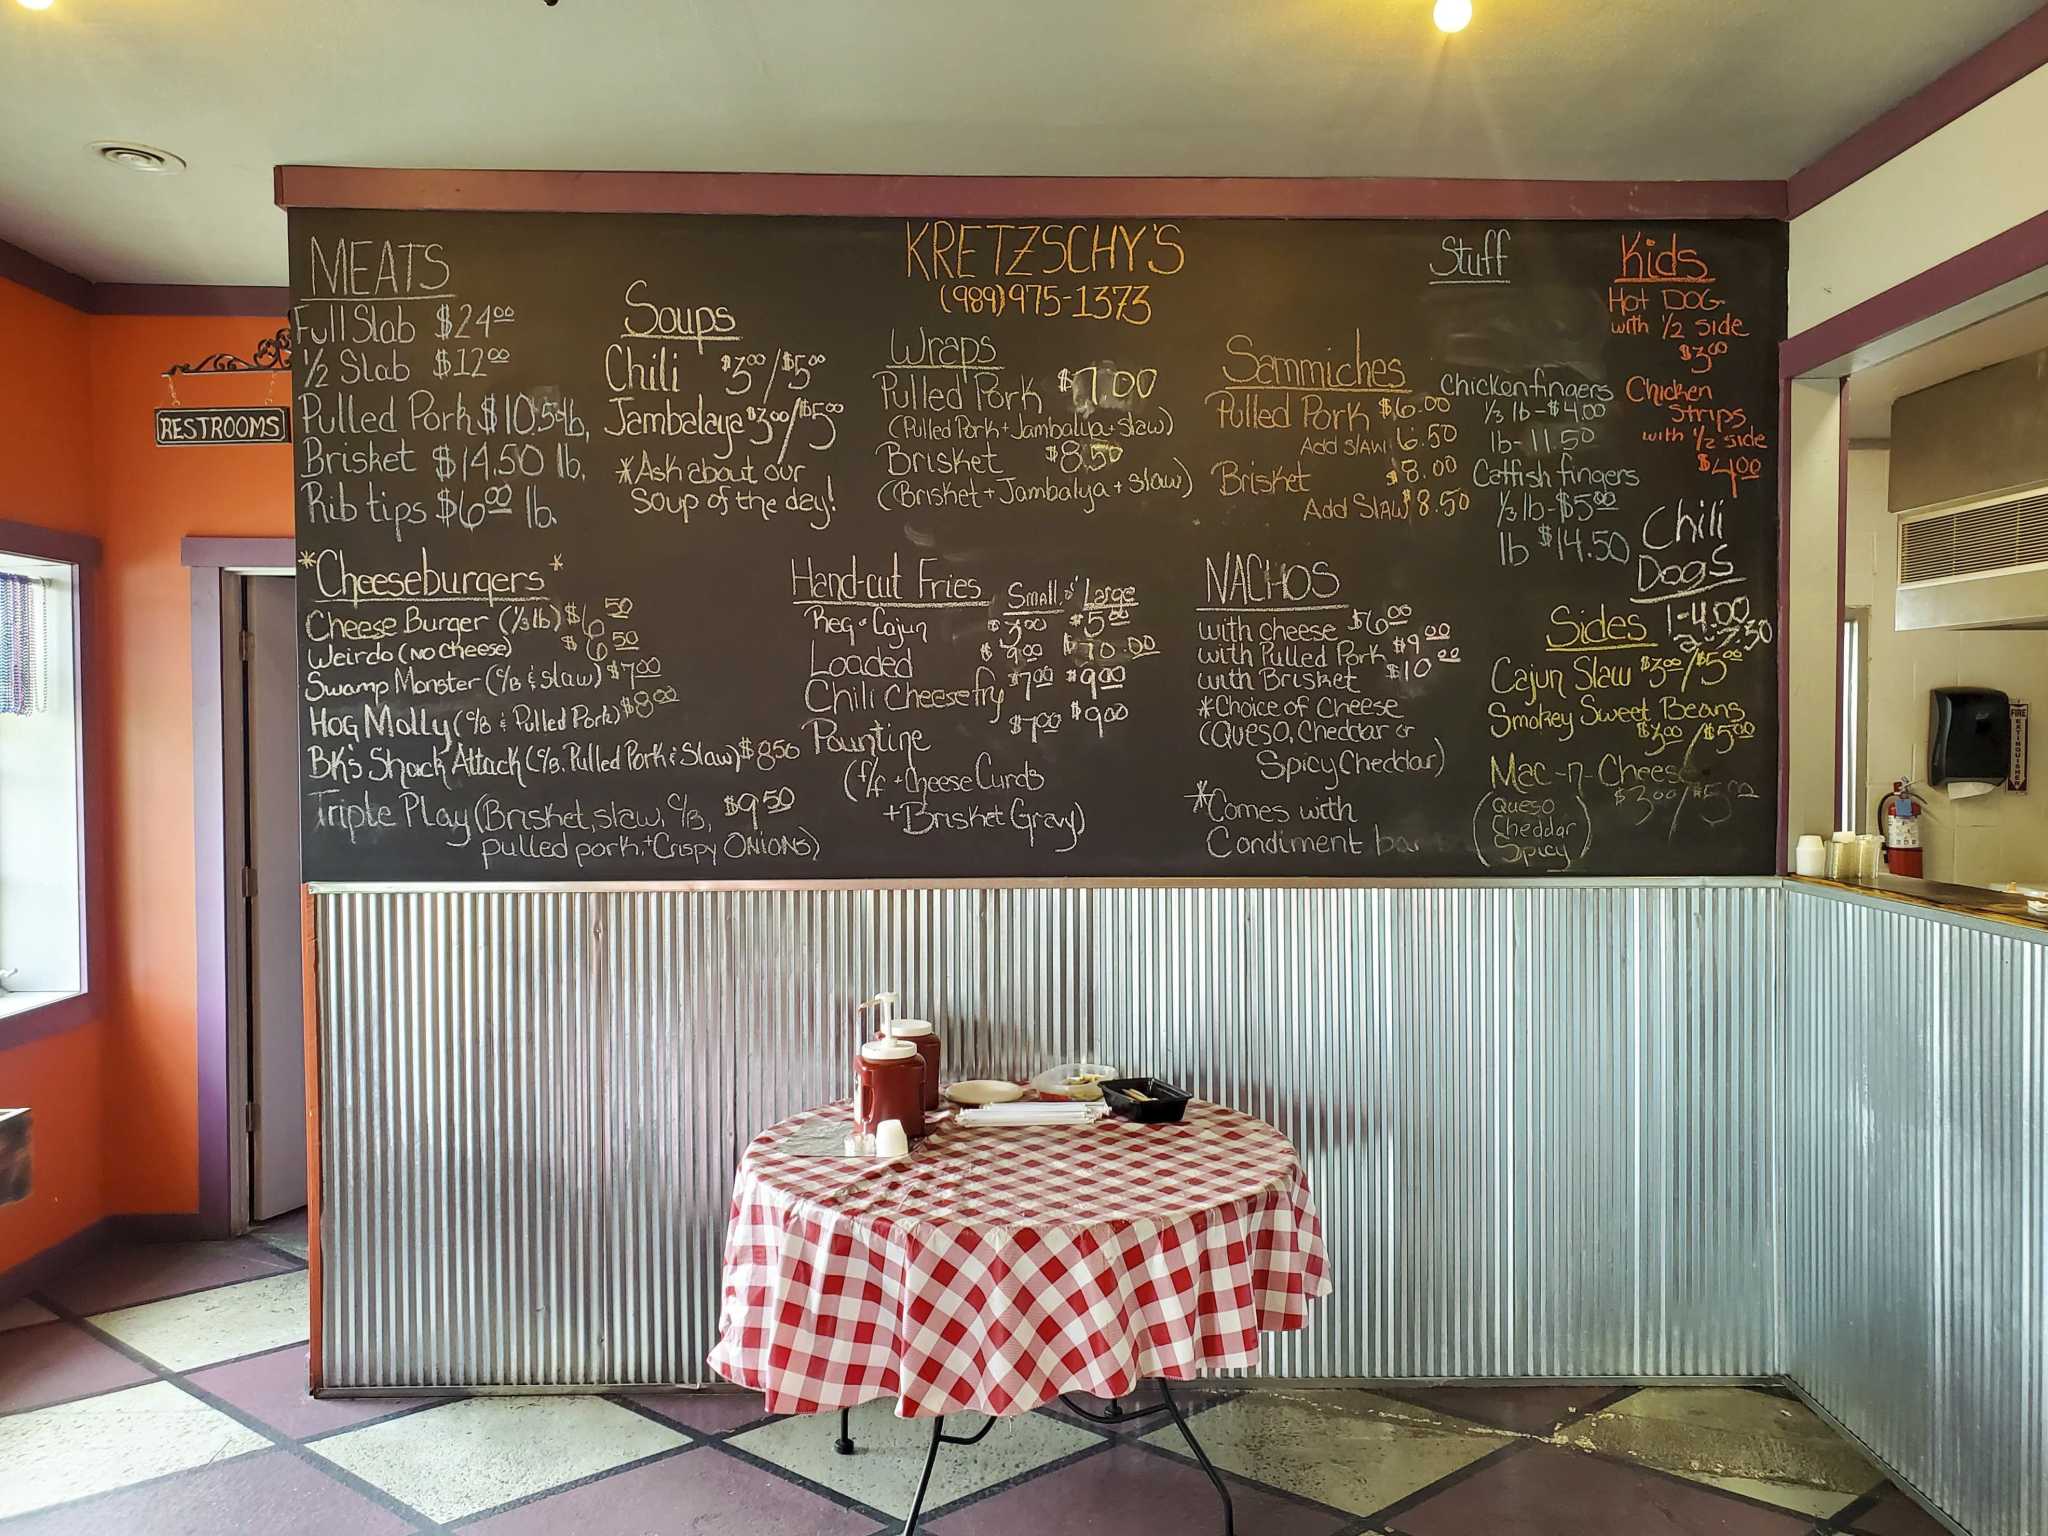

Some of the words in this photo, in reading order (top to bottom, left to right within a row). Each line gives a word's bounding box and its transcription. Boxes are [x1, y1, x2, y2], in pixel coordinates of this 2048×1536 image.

[310, 235, 450, 296] MEATS
[906, 221, 1185, 281] KRETZSCHY'S
[1429, 229, 1511, 276] Stuff
[1621, 232, 1708, 280] Kids
[624, 279, 736, 355] Soups
[1608, 286, 1650, 315] Hot
[294, 303, 345, 344] Full
[353, 303, 416, 344] Slab
[1611, 314, 1648, 335] with
[1695, 313, 1750, 337] side
[340, 348, 410, 385] Slab
[605, 343, 681, 392] Chili
[890, 327, 997, 384] Wraps
[1222, 327, 1406, 388] Sammiches
[872, 370, 963, 412] Pulled
[974, 370, 1042, 414] Pork
[1626, 376, 1712, 406] Chicken
[160, 416, 280, 440] RESTROOMS
[298, 392, 397, 434] Pulled
[409, 389, 476, 435] Pork
[954, 414, 1000, 439] Pork
[1204, 390, 1292, 429] Pulled
[1301, 394, 1370, 432] Pork
[1668, 403, 1747, 432] Strips
[1300, 436, 1338, 455] Add
[1642, 427, 1684, 442] with
[1724, 425, 1768, 449] side
[300, 437, 417, 477] Brisket
[688, 454, 758, 484] about
[764, 463, 806, 483] our
[875, 441, 1004, 476] Brisket
[1473, 458, 1552, 488] Catfish
[1556, 452, 1640, 492] fingers
[1210, 459, 1312, 496] Brisket
[300, 481, 358, 524] Rib
[366, 481, 427, 543] tips
[707, 485, 731, 516] of
[736, 488, 778, 520] the
[1303, 496, 1347, 521] Add
[1642, 497, 1724, 550] Chili
[1500, 531, 1530, 566] lb
[919, 558, 982, 600] Fries
[1084, 578, 1136, 607] Large
[1206, 551, 1339, 605] NACHOS
[305, 609, 397, 642] Cheese
[403, 606, 488, 645] Burger
[871, 607, 927, 650] Cajun
[1199, 618, 1254, 642] with
[1546, 604, 1647, 649] Sides
[308, 641, 394, 670] Weirdo
[811, 640, 913, 678] Loaded
[1198, 643, 1254, 668] with
[1259, 642, 1328, 668] Pulled
[1337, 639, 1388, 667] Pork
[305, 670, 389, 706] Swamp
[395, 666, 481, 694] Monster
[805, 679, 875, 716] Chili
[1197, 667, 1254, 690] with
[1259, 665, 1361, 693] Brisket
[1491, 656, 1567, 706] Cajun
[1573, 655, 1632, 691] Slaw
[1284, 696, 1310, 717] of
[1316, 696, 1404, 719] Cheese
[1488, 701, 1573, 743] Smokey
[1580, 694, 1651, 726] Sweet
[1659, 696, 1746, 723] Beans
[364, 703, 453, 752] Molly
[513, 703, 566, 732] Pulled
[1297, 719, 1390, 744] Cheddar
[368, 745, 452, 791] Shack
[451, 742, 526, 788] Attack
[562, 741, 620, 773] Pulled
[624, 739, 666, 771] Pork
[975, 752, 1045, 792] Curds
[1256, 750, 1339, 790] Spicy
[306, 788, 397, 844] Triple
[398, 791, 471, 847] Play
[1300, 795, 1358, 824] with
[1492, 814, 1577, 839] Cheddar
[482, 831, 569, 870] pulled
[1206, 825, 1364, 858] Condiment
[1494, 834, 1572, 872] Spicy
